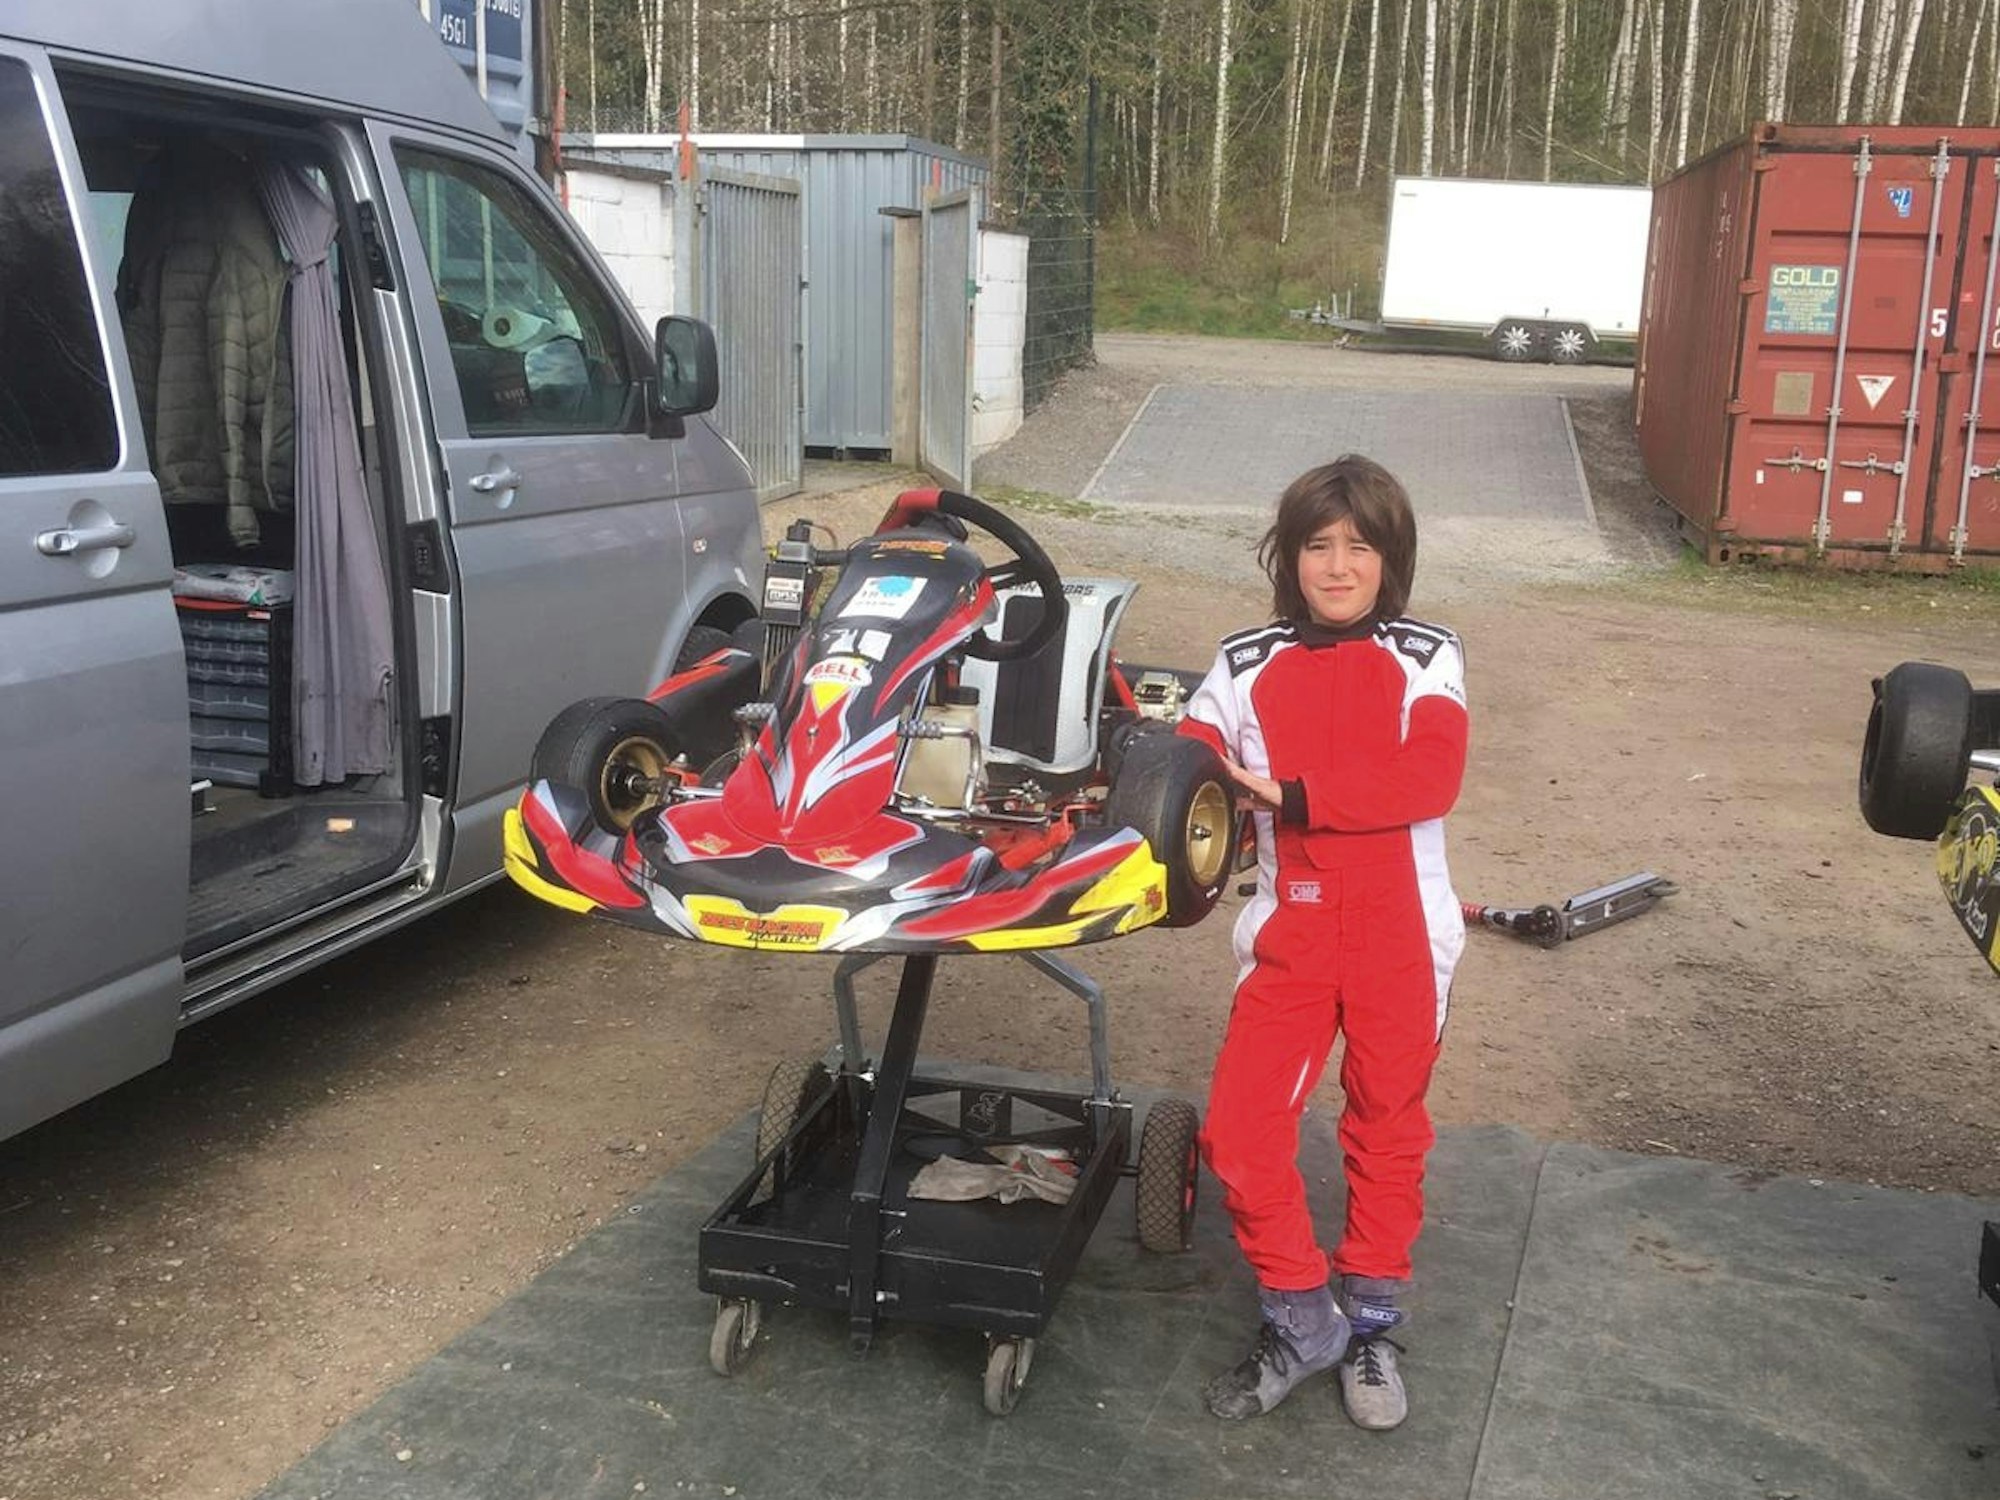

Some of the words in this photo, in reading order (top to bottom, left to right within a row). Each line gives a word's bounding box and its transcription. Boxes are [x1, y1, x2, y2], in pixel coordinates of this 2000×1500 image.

[1773, 267, 1838, 287] GOLD
[1931, 308, 1948, 337] 5
[811, 662, 862, 681] BELL
